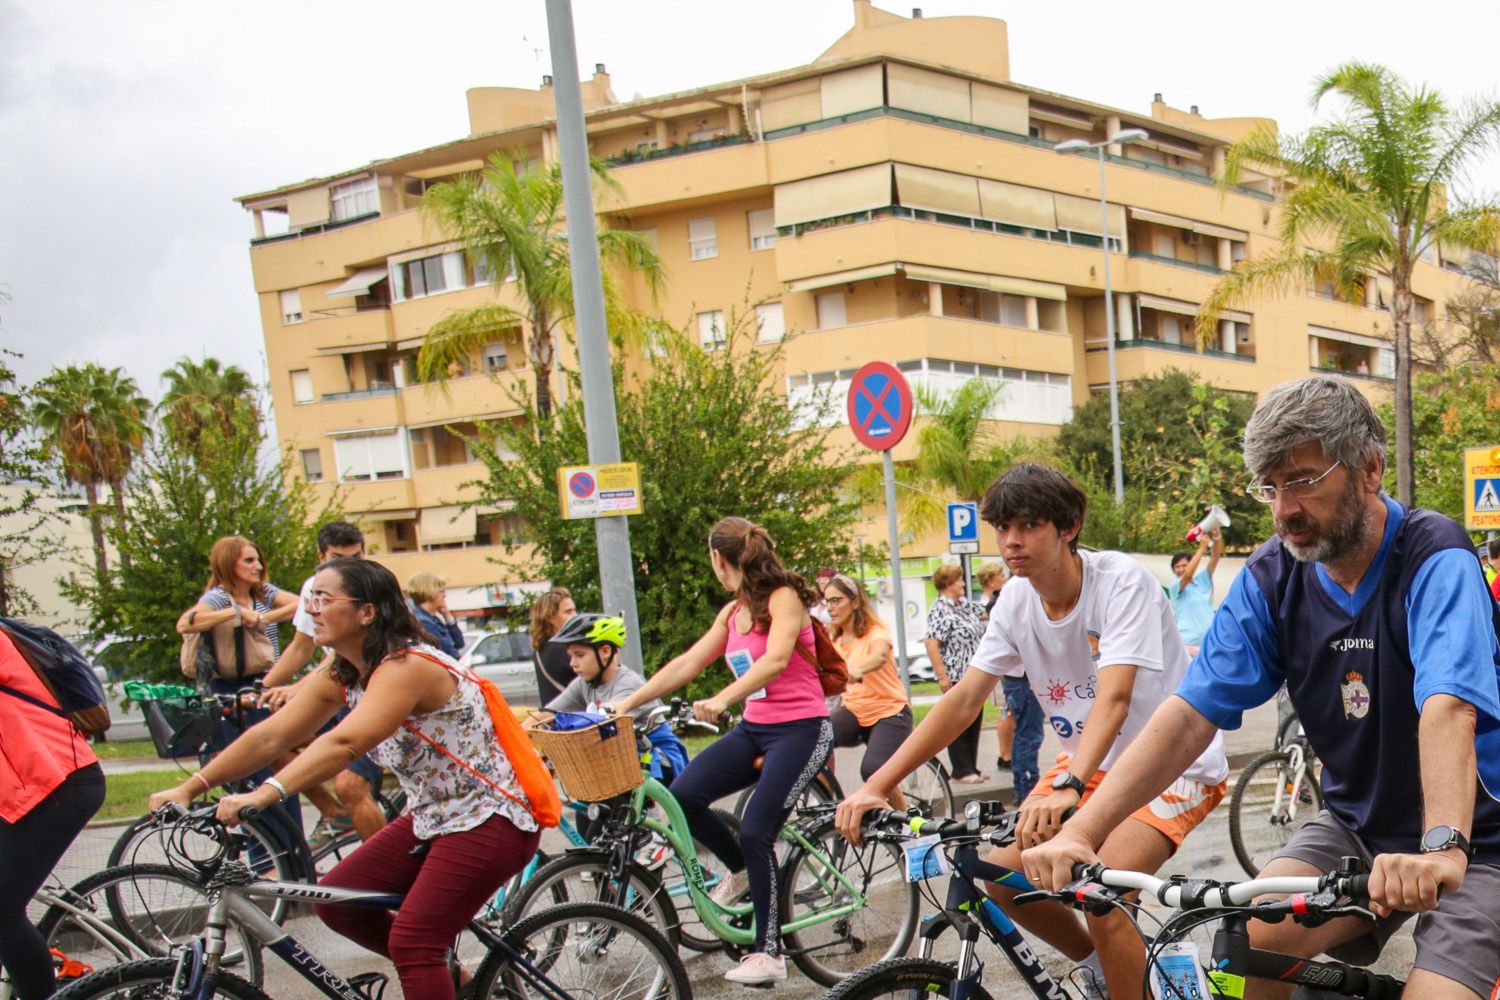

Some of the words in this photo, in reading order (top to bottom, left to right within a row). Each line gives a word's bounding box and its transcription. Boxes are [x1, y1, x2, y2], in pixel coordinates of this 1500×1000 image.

[952, 508, 971, 536] P
[1340, 638, 1375, 652] Joma
[270, 886, 333, 899] 3700
[1298, 965, 1344, 987] 540
